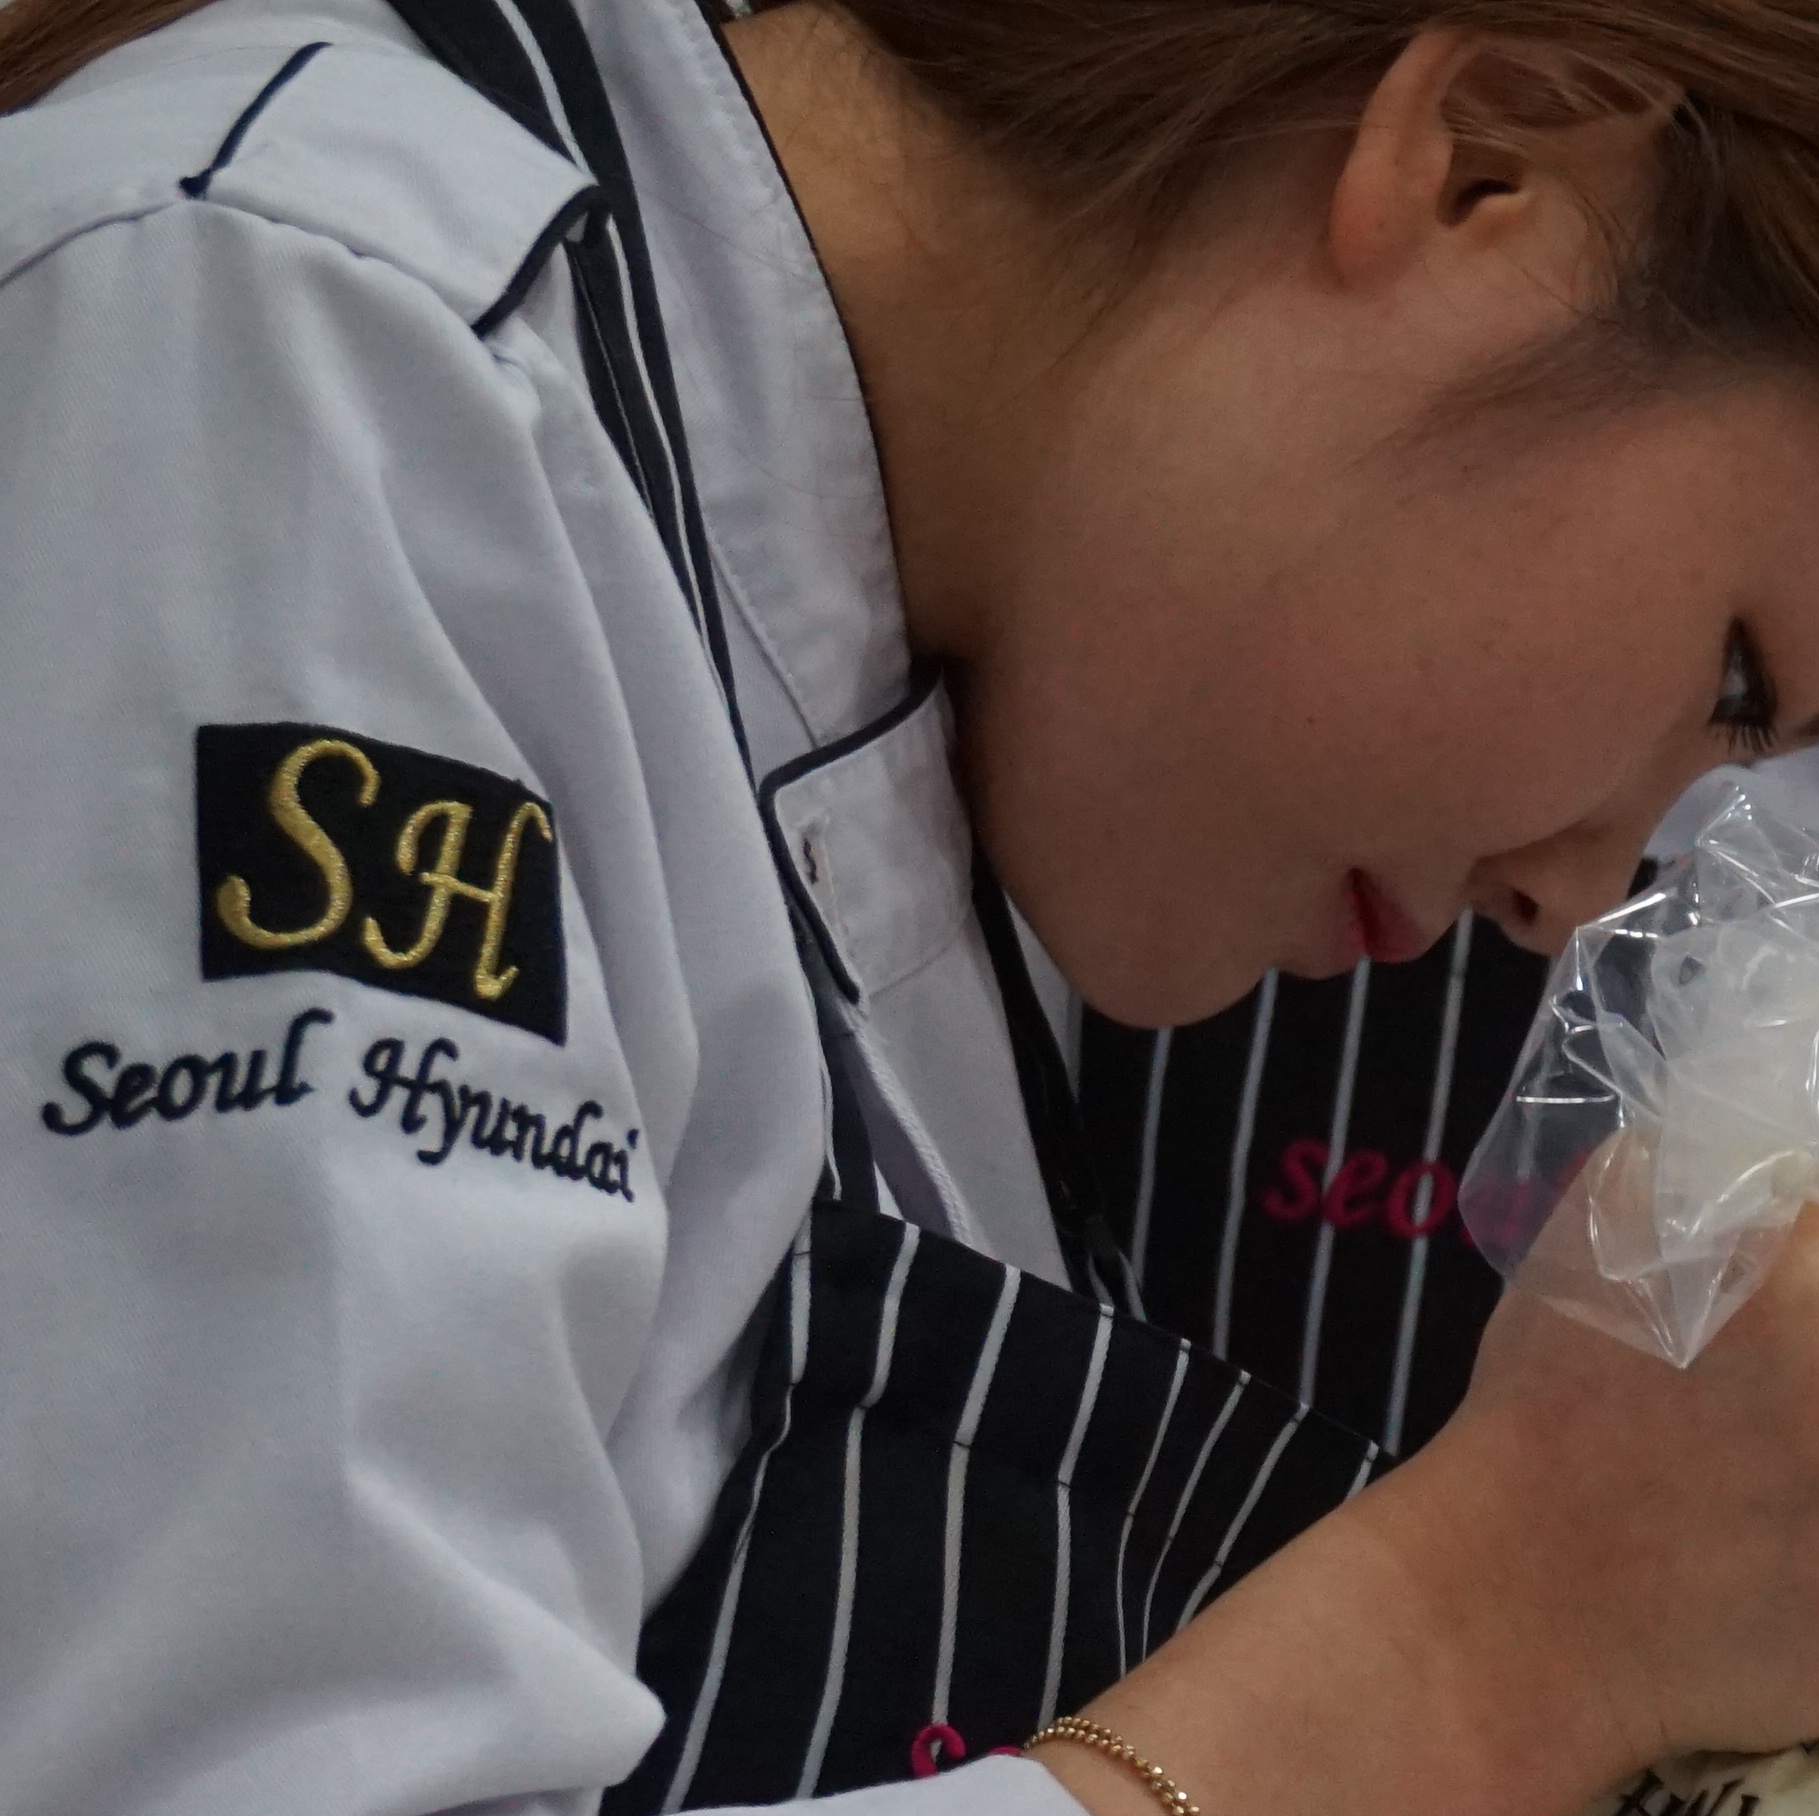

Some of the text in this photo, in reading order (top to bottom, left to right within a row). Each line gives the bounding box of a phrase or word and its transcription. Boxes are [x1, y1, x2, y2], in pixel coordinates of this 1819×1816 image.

[215, 738, 553, 1000] SH
[42, 1007, 640, 1203] Seoul Hyundai
